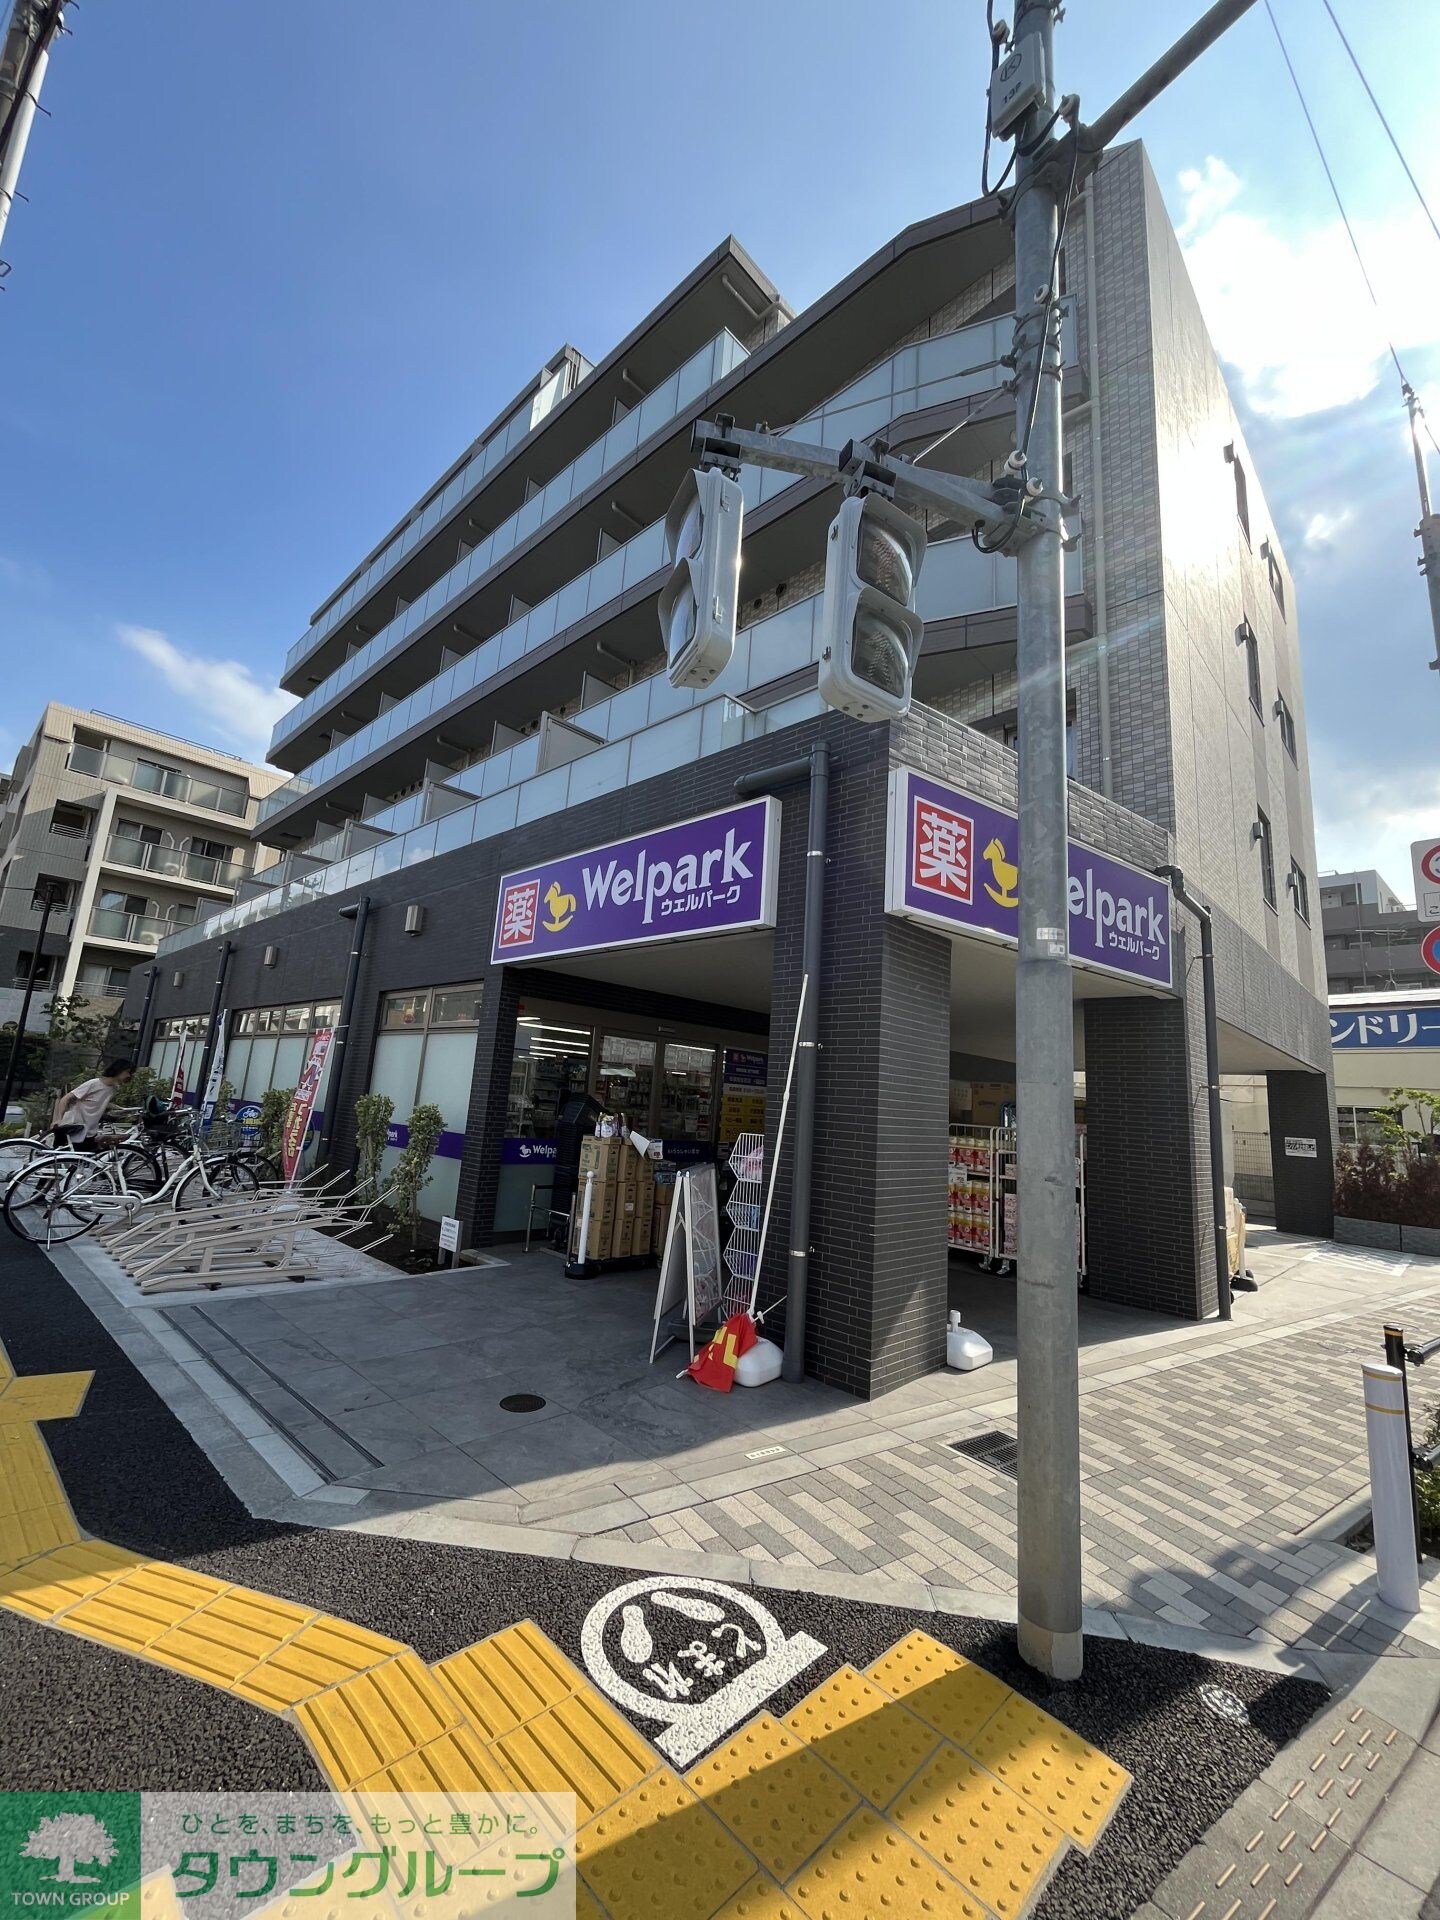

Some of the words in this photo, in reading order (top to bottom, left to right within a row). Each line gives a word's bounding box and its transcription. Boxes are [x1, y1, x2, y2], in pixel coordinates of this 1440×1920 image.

[582, 827, 753, 925] Welpark
[920, 811, 968, 892] 薬
[503, 888, 536, 941] 薬
[1068, 868, 1166, 948] elpark
[532, 1144, 558, 1159] Welpa
[642, 1622, 762, 1699] とまれ
